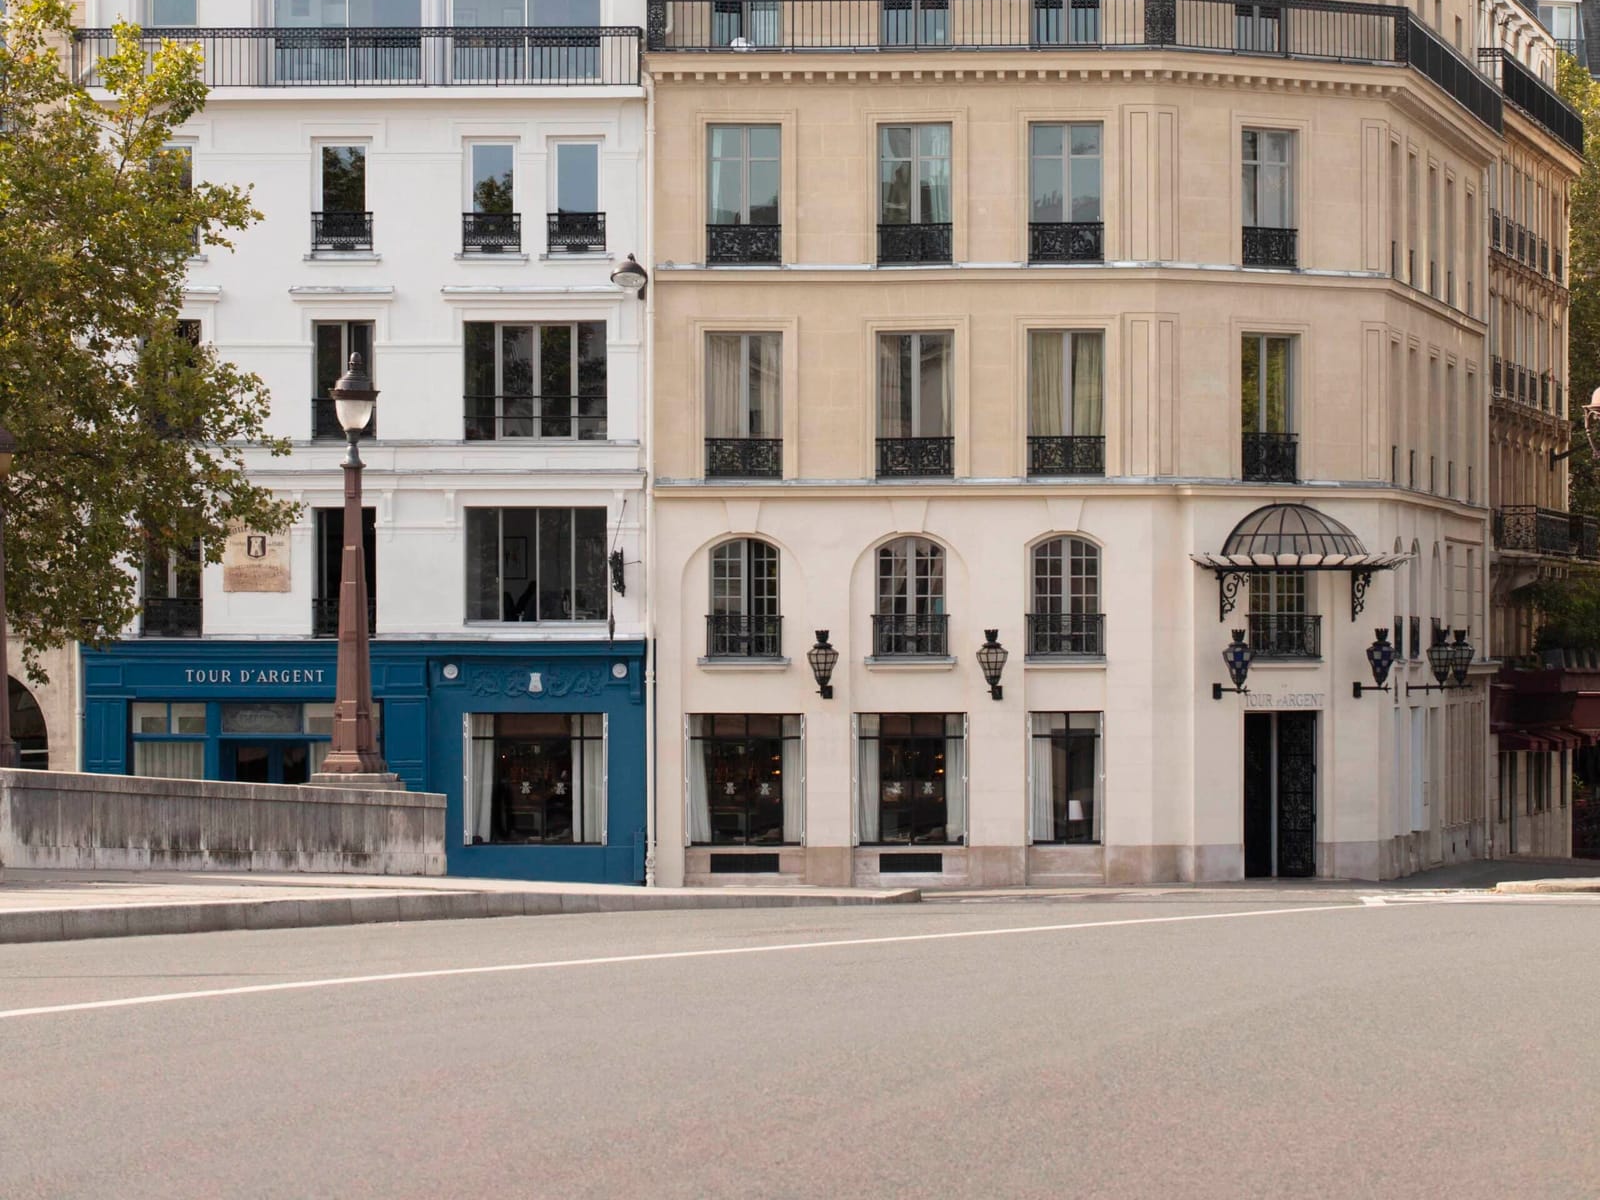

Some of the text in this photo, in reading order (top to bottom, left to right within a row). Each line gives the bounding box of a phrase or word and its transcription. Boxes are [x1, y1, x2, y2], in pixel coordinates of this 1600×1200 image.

[185, 669, 325, 683] TOUR D'ARGENT
[1246, 693, 1273, 707] TOUR
